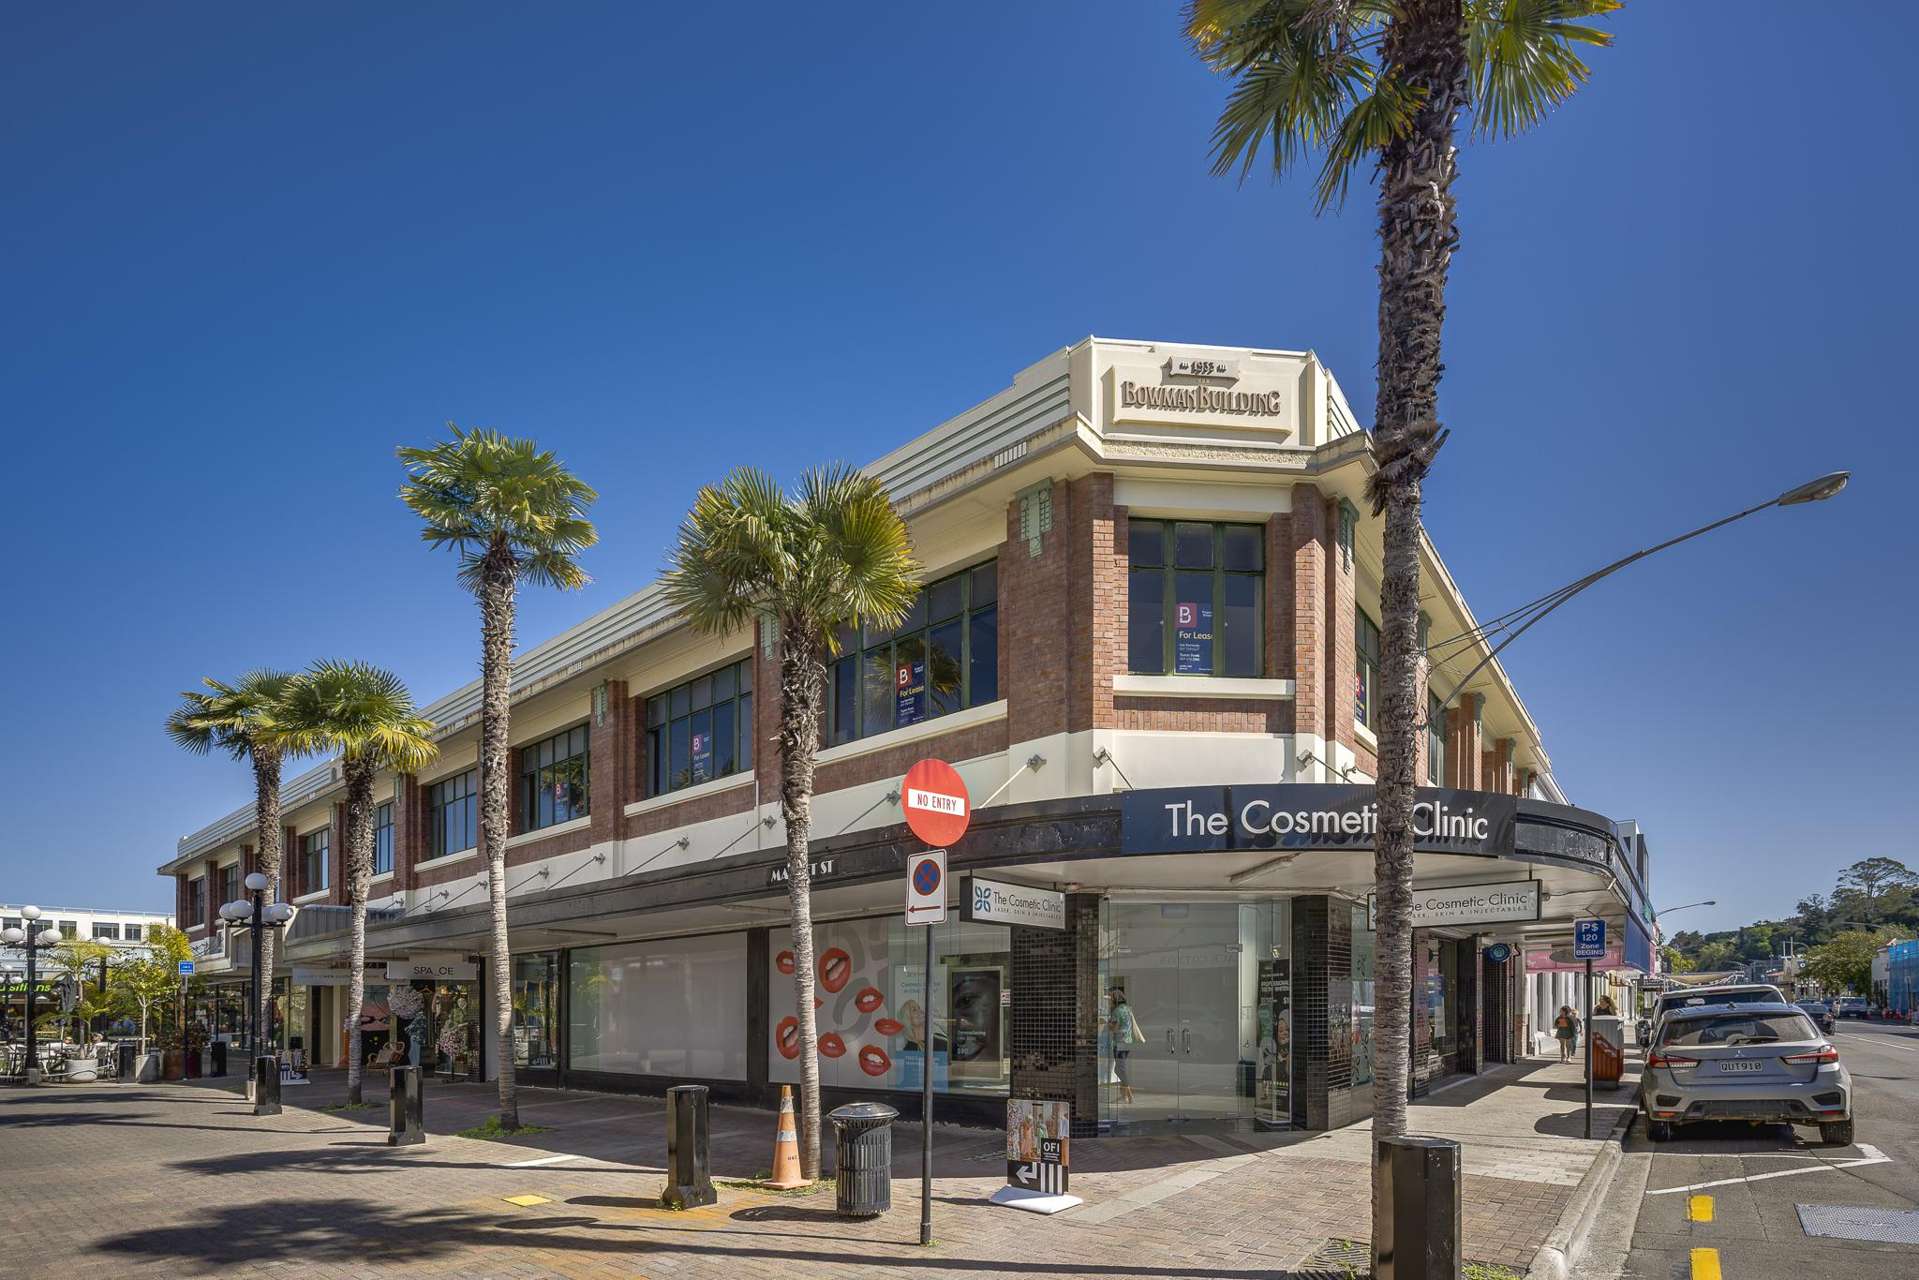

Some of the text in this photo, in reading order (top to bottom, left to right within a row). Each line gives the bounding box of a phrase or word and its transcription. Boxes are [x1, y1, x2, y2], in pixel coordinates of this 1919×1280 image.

[1179, 631, 1191, 639] For
[917, 793, 957, 812] NO ENTRY
[1165, 799, 1489, 839] The Cosmeti Clinic
[820, 860, 835, 874] ST
[993, 891, 1061, 913] The Cosmetic Clinic
[1425, 895, 1485, 911] Cosmetic
[1488, 892, 1528, 906] Clinic
[1582, 934, 1598, 942] 120
[1043, 1141, 1060, 1153] OFI
